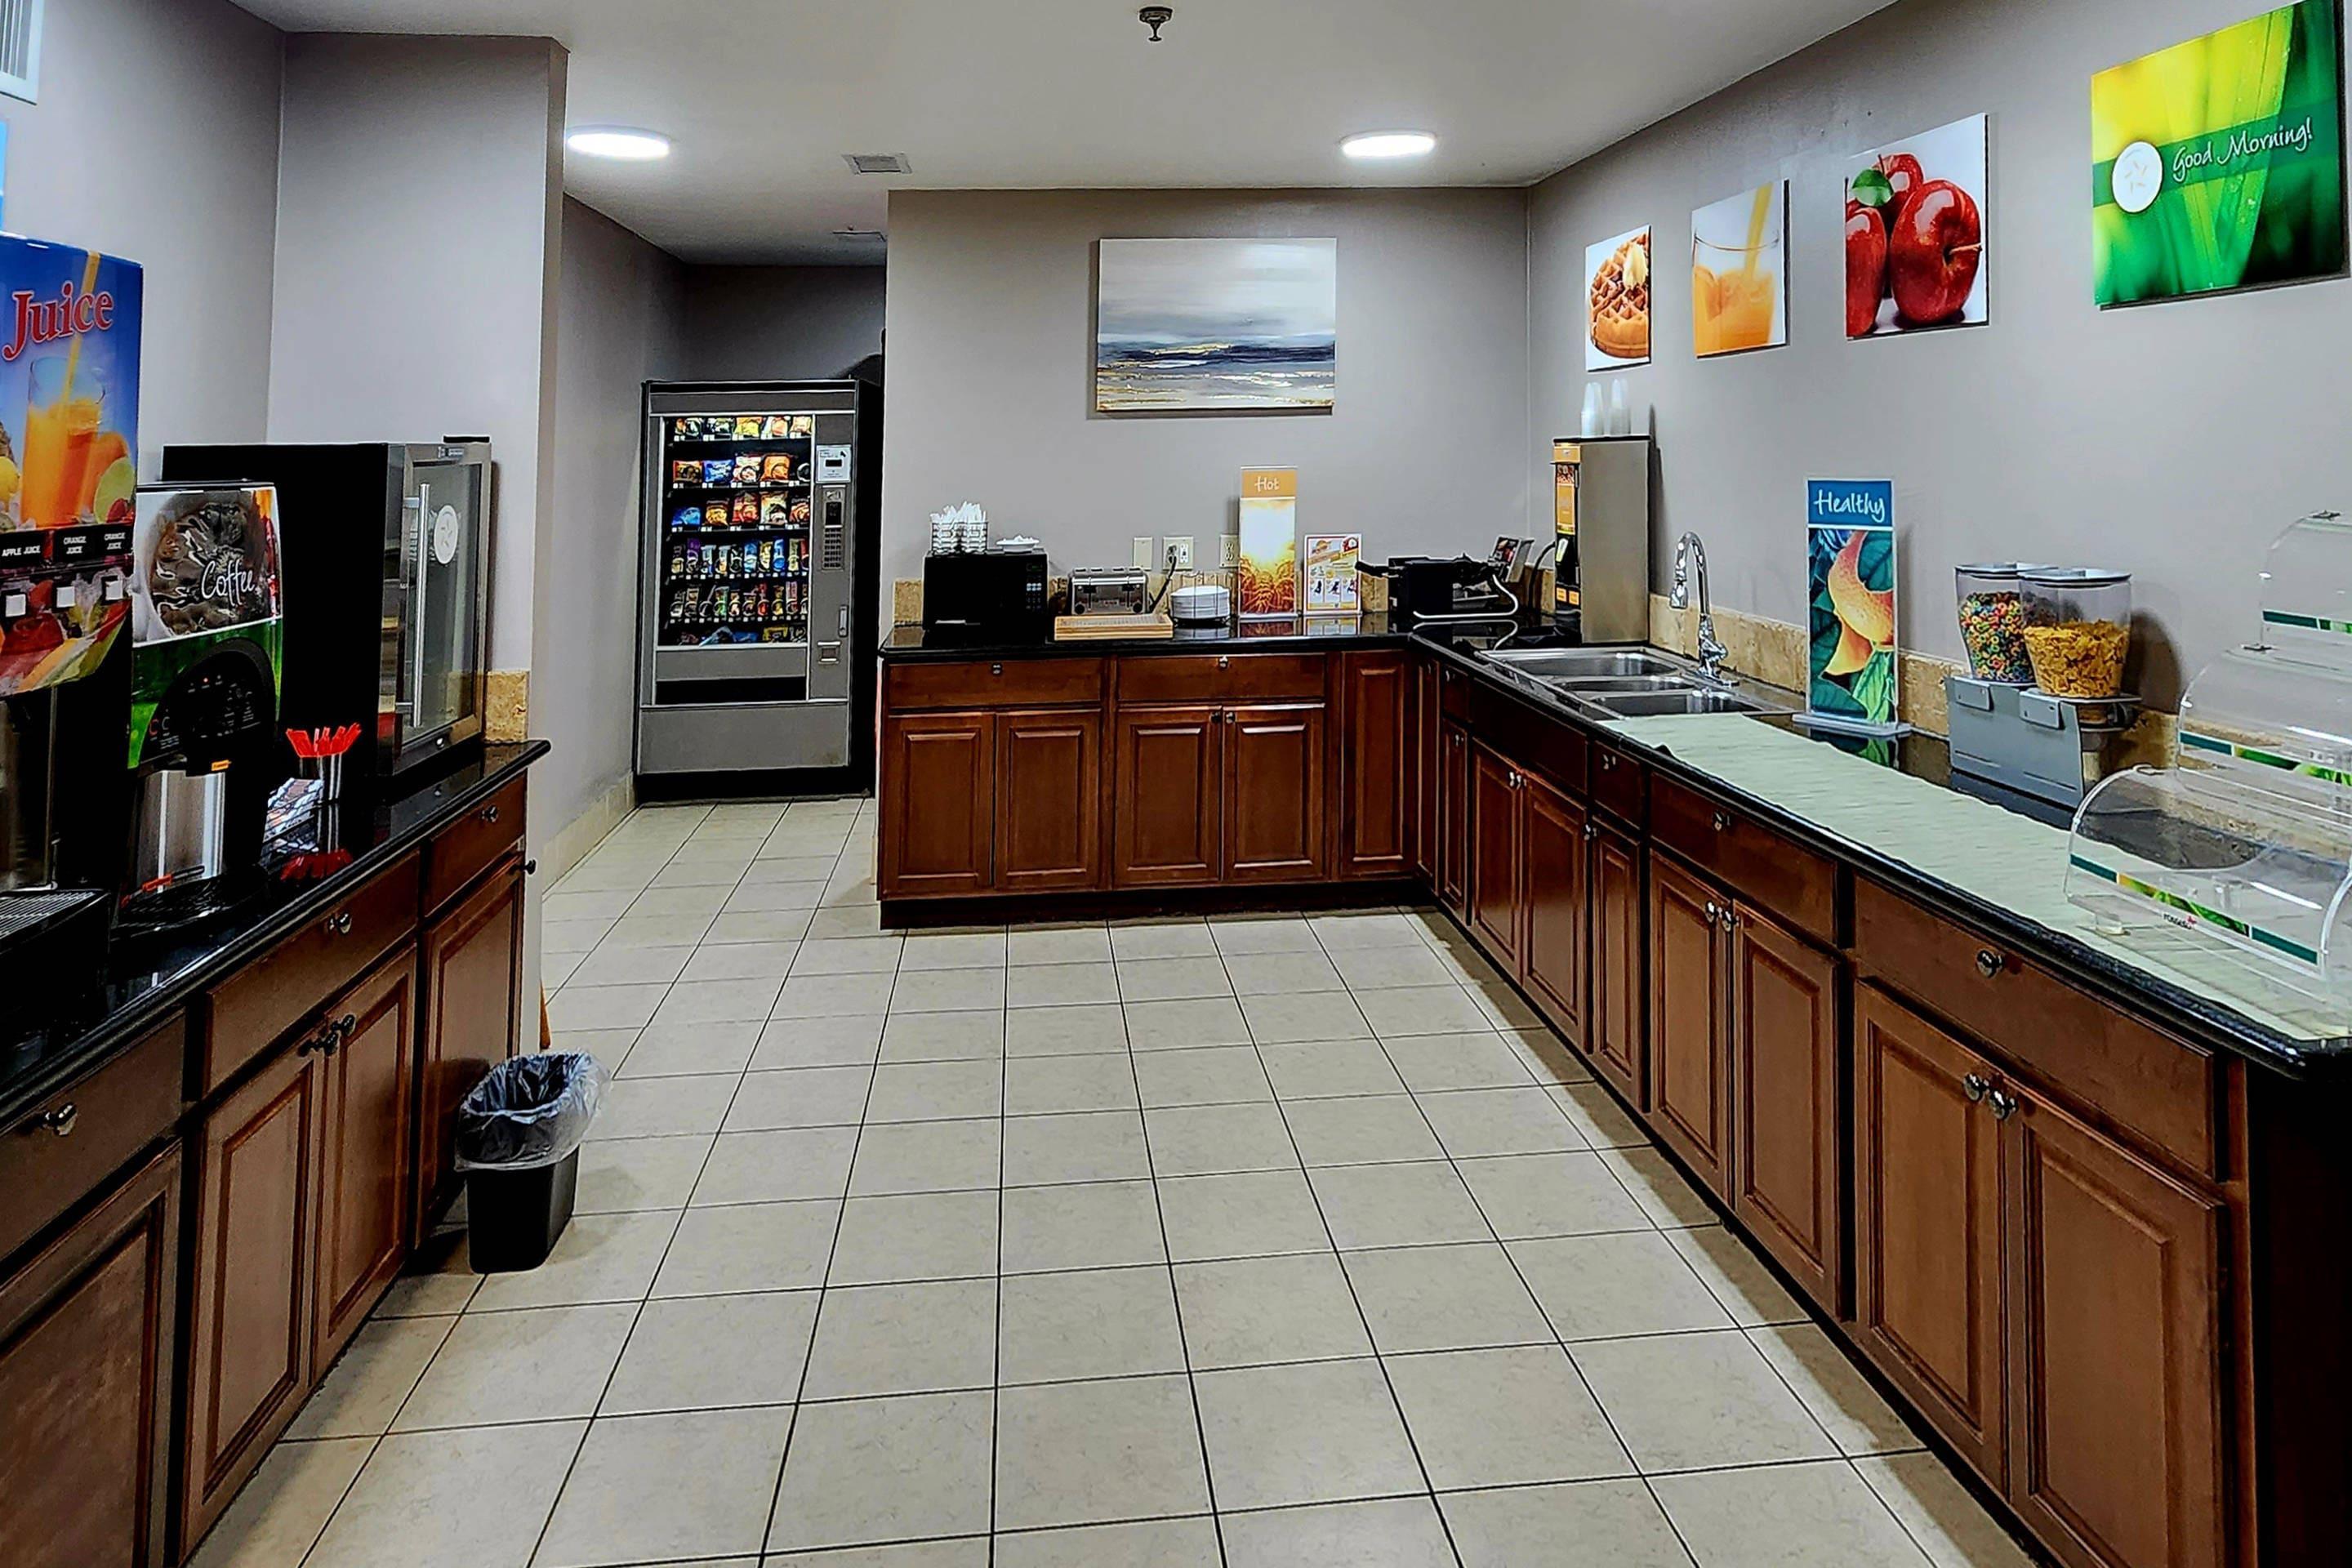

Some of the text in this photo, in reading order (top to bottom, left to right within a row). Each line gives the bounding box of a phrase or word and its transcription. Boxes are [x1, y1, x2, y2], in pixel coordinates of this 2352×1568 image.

[2172, 117, 2314, 183] Good Morning!
[2, 280, 114, 361] Juice
[1254, 476, 1280, 492] Hot
[1813, 488, 1886, 523] Healthy
[63, 536, 87, 546] ORANGE
[104, 532, 126, 541] ORANGE
[2, 545, 41, 557] APPLE JUICE
[66, 546, 83, 555] JUICE
[107, 541, 122, 550] JUICE
[201, 560, 256, 607] Coffee
